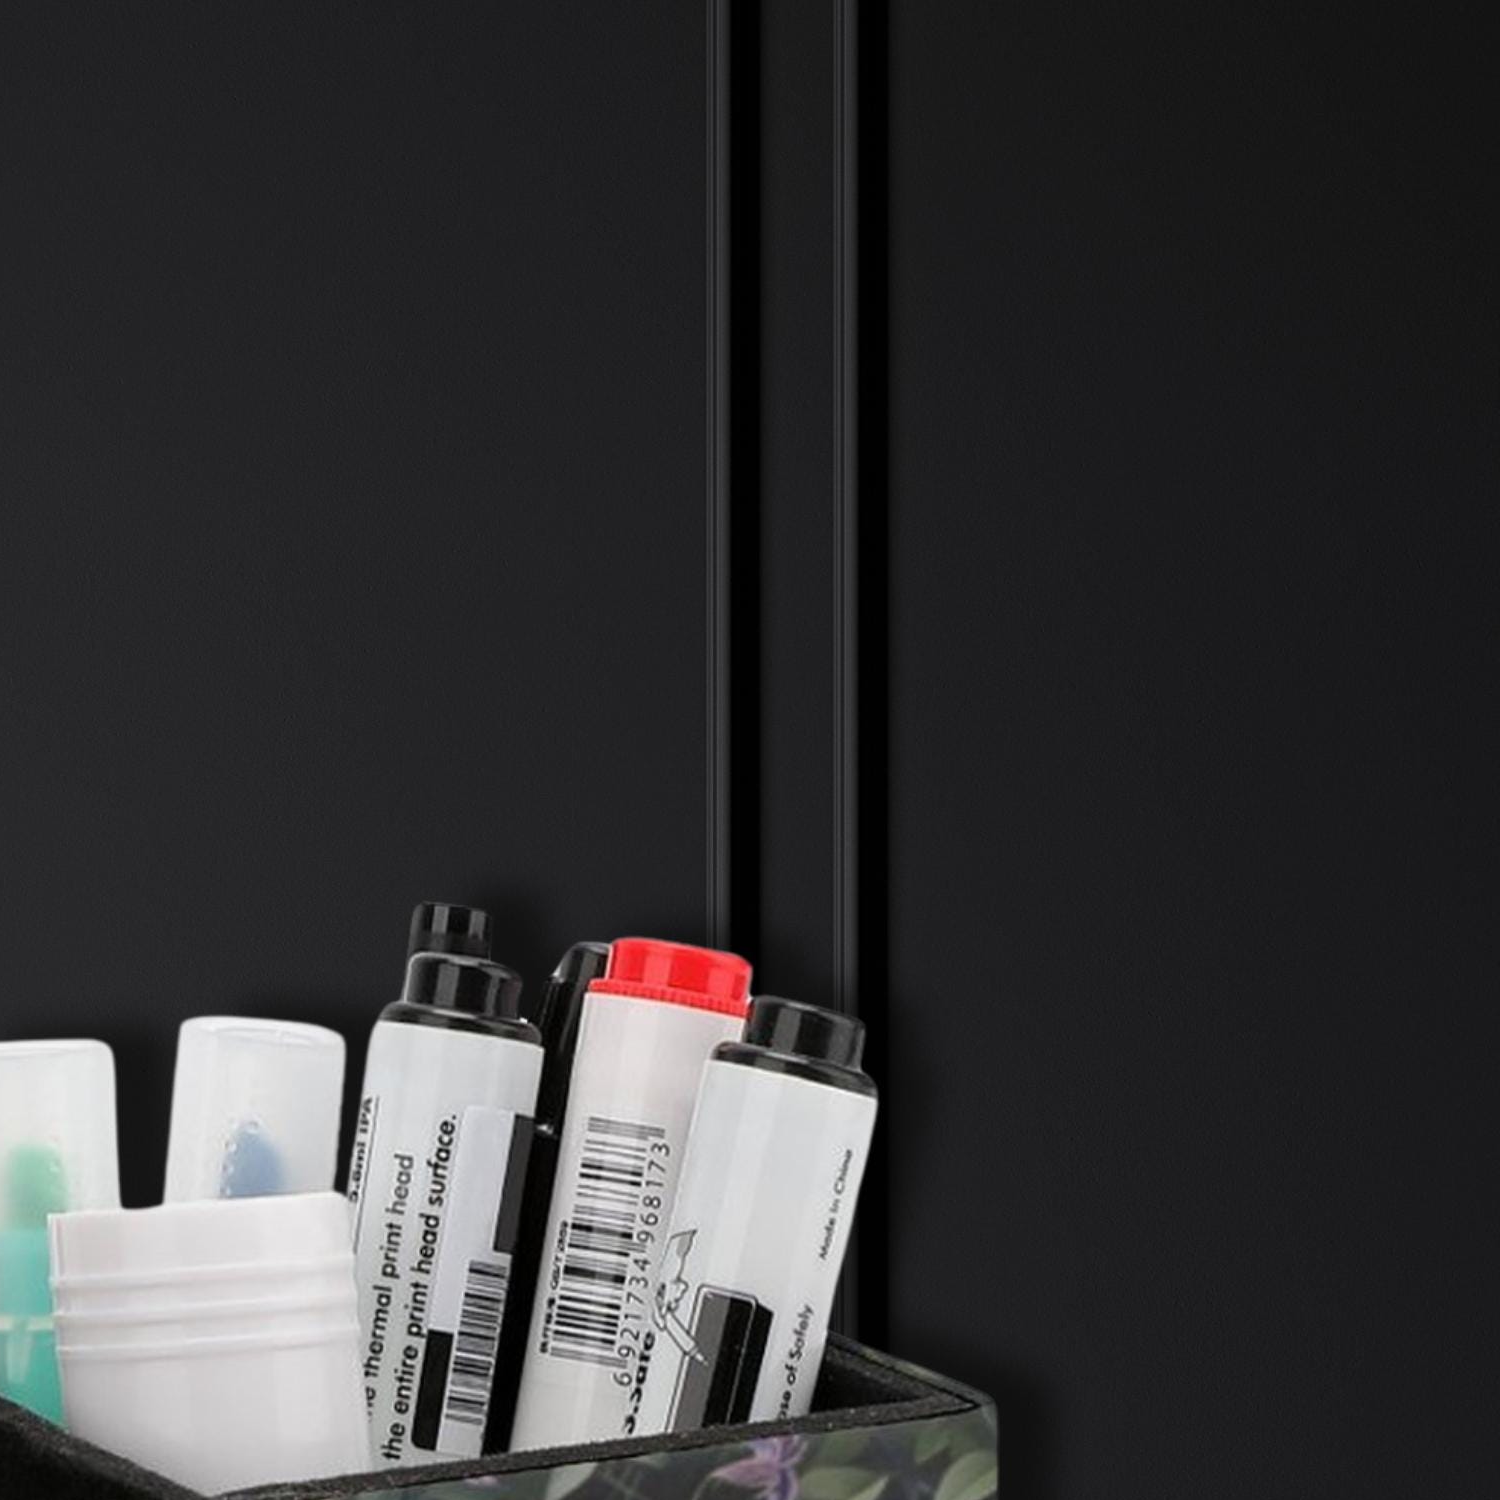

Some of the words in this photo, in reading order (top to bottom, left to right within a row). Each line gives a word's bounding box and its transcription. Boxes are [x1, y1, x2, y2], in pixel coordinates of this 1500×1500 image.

[384, 1154, 415, 1215] head
[420, 1113, 458, 1208] surface.
[833, 1148, 853, 1196] China
[828, 1198, 840, 1214] in
[378, 1221, 406, 1279] print
[414, 1214, 443, 1277] head
[818, 1217, 837, 1261] Made
[363, 1284, 393, 1380] thermal
[403, 1281, 429, 1340] print
[392, 1344, 419, 1415] entire
[784, 1363, 798, 1387] of
[380, 1422, 406, 1461] the
